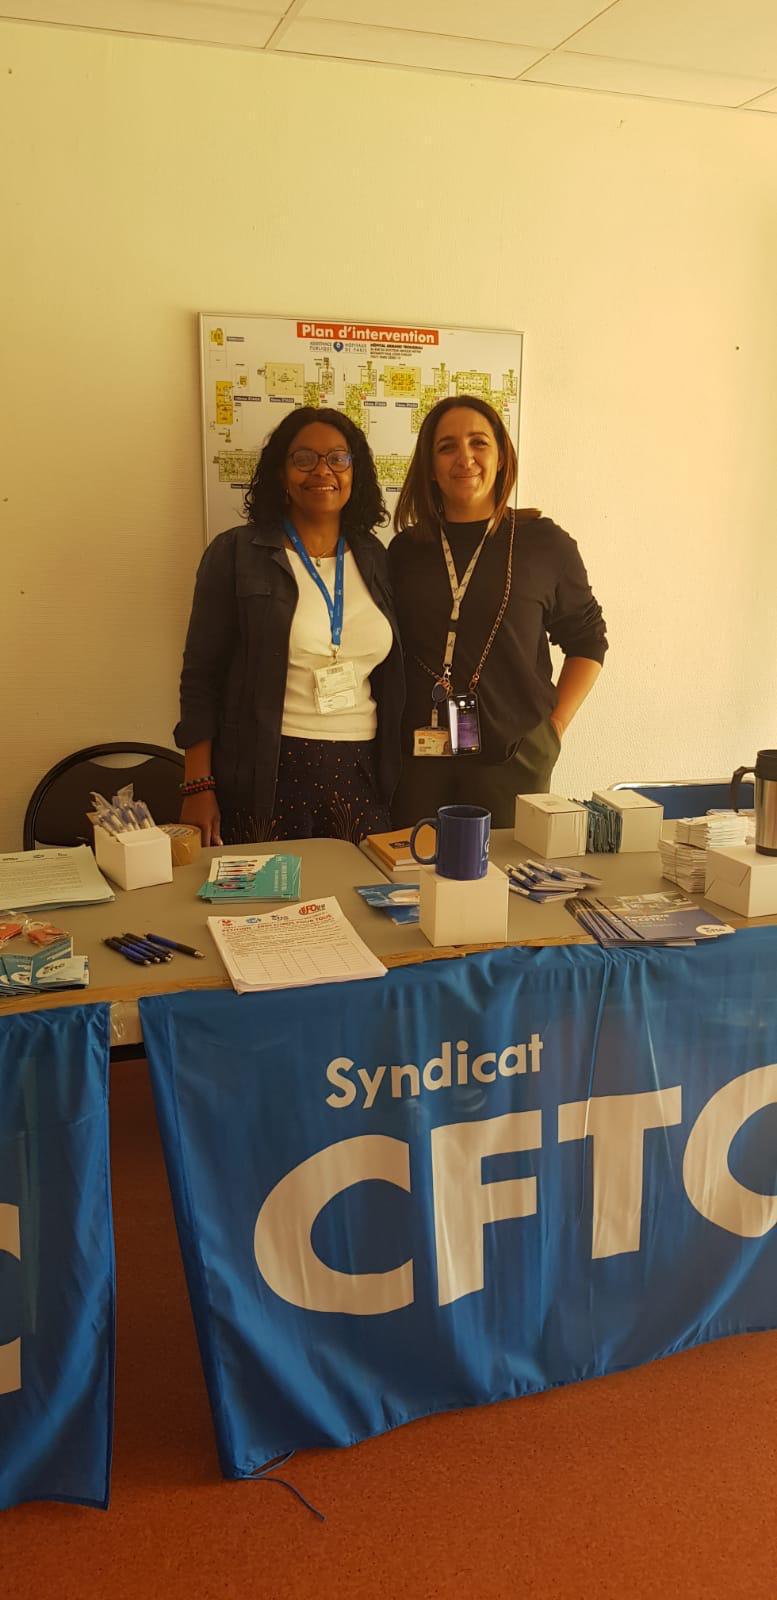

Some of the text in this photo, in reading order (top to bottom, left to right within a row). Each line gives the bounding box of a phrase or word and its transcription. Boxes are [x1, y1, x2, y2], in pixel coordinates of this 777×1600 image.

[302, 323, 436, 344] Plan d'intervention
[325, 1033, 544, 1110] Syndicat
[253, 1063, 777, 1316] CFTC
